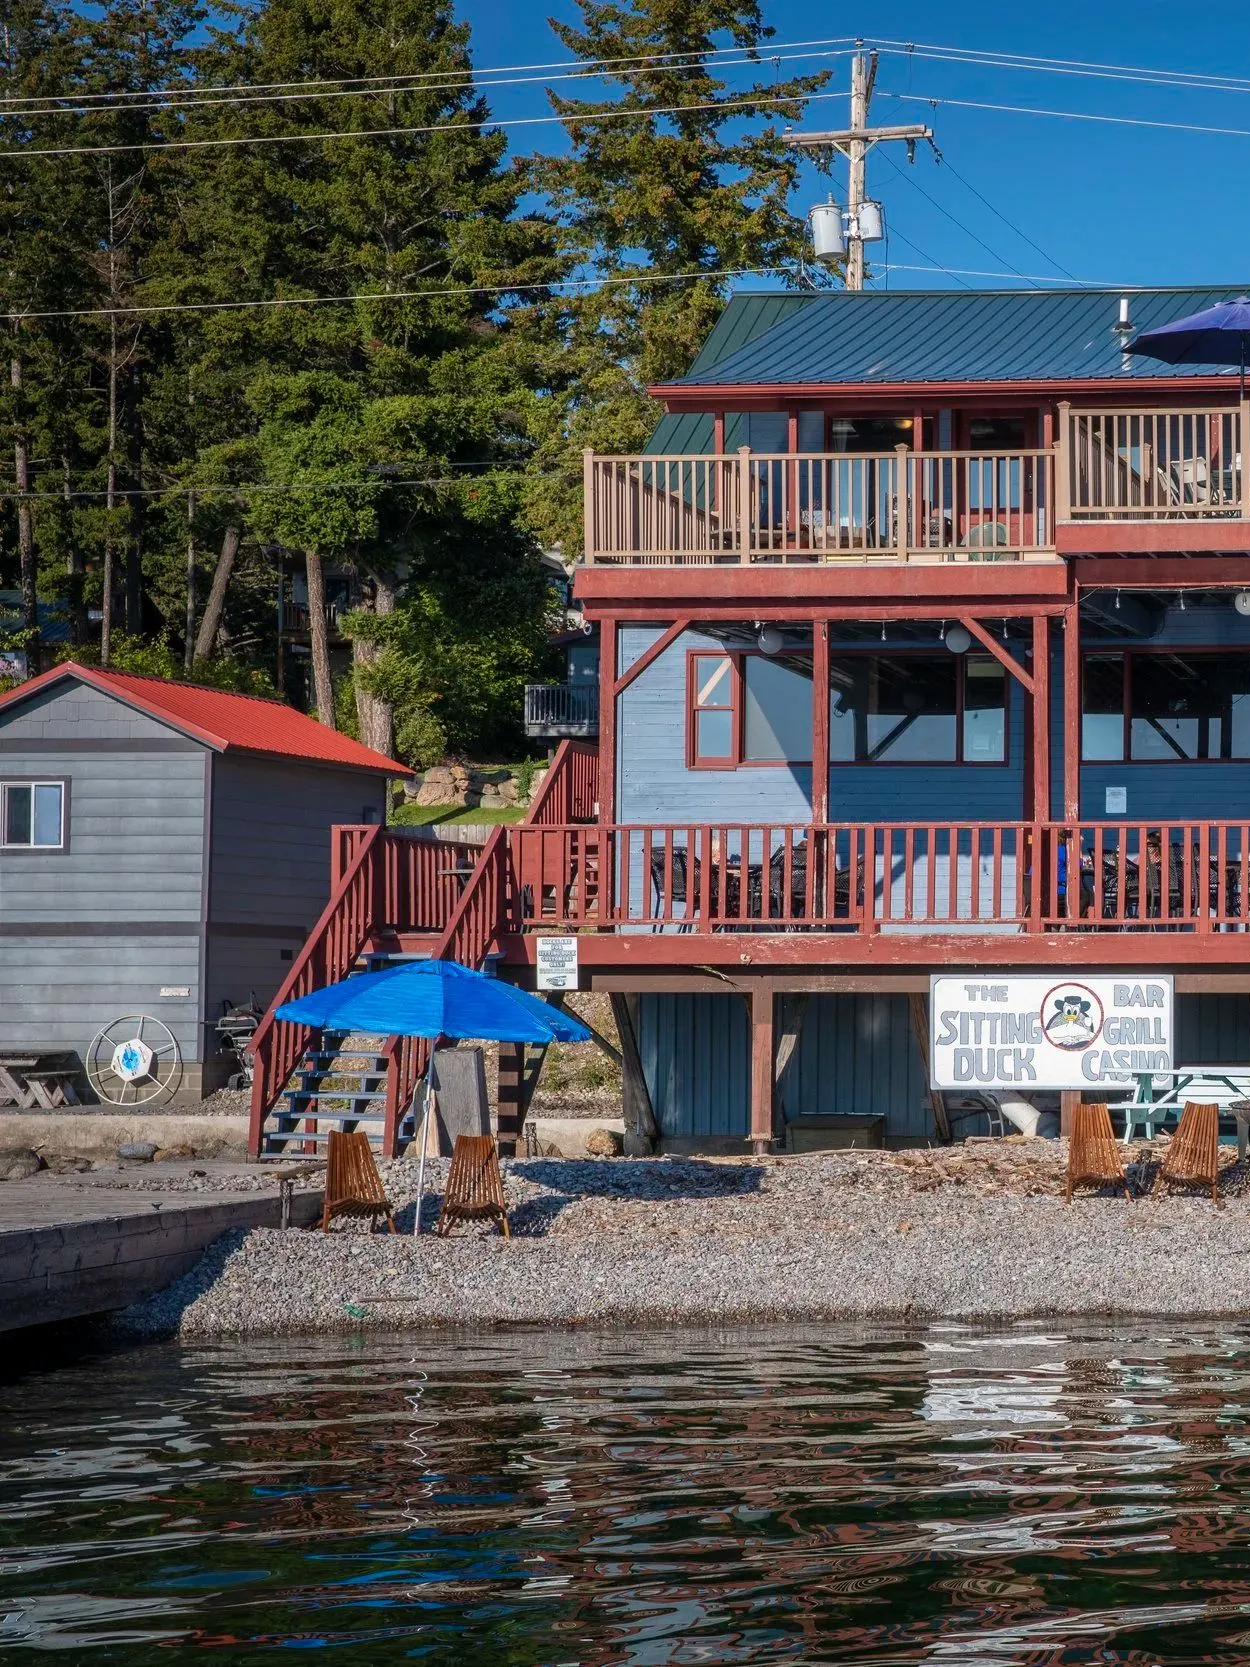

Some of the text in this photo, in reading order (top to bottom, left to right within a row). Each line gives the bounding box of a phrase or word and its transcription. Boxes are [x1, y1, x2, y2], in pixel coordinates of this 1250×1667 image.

[964, 984, 1008, 1003] THE
[1113, 984, 1165, 1008] BAR
[935, 1010, 1043, 1046] SITTING
[1103, 1017, 1167, 1046] GRILL
[953, 1048, 1037, 1082] DUCK
[1081, 1050, 1170, 1082] CASINO
